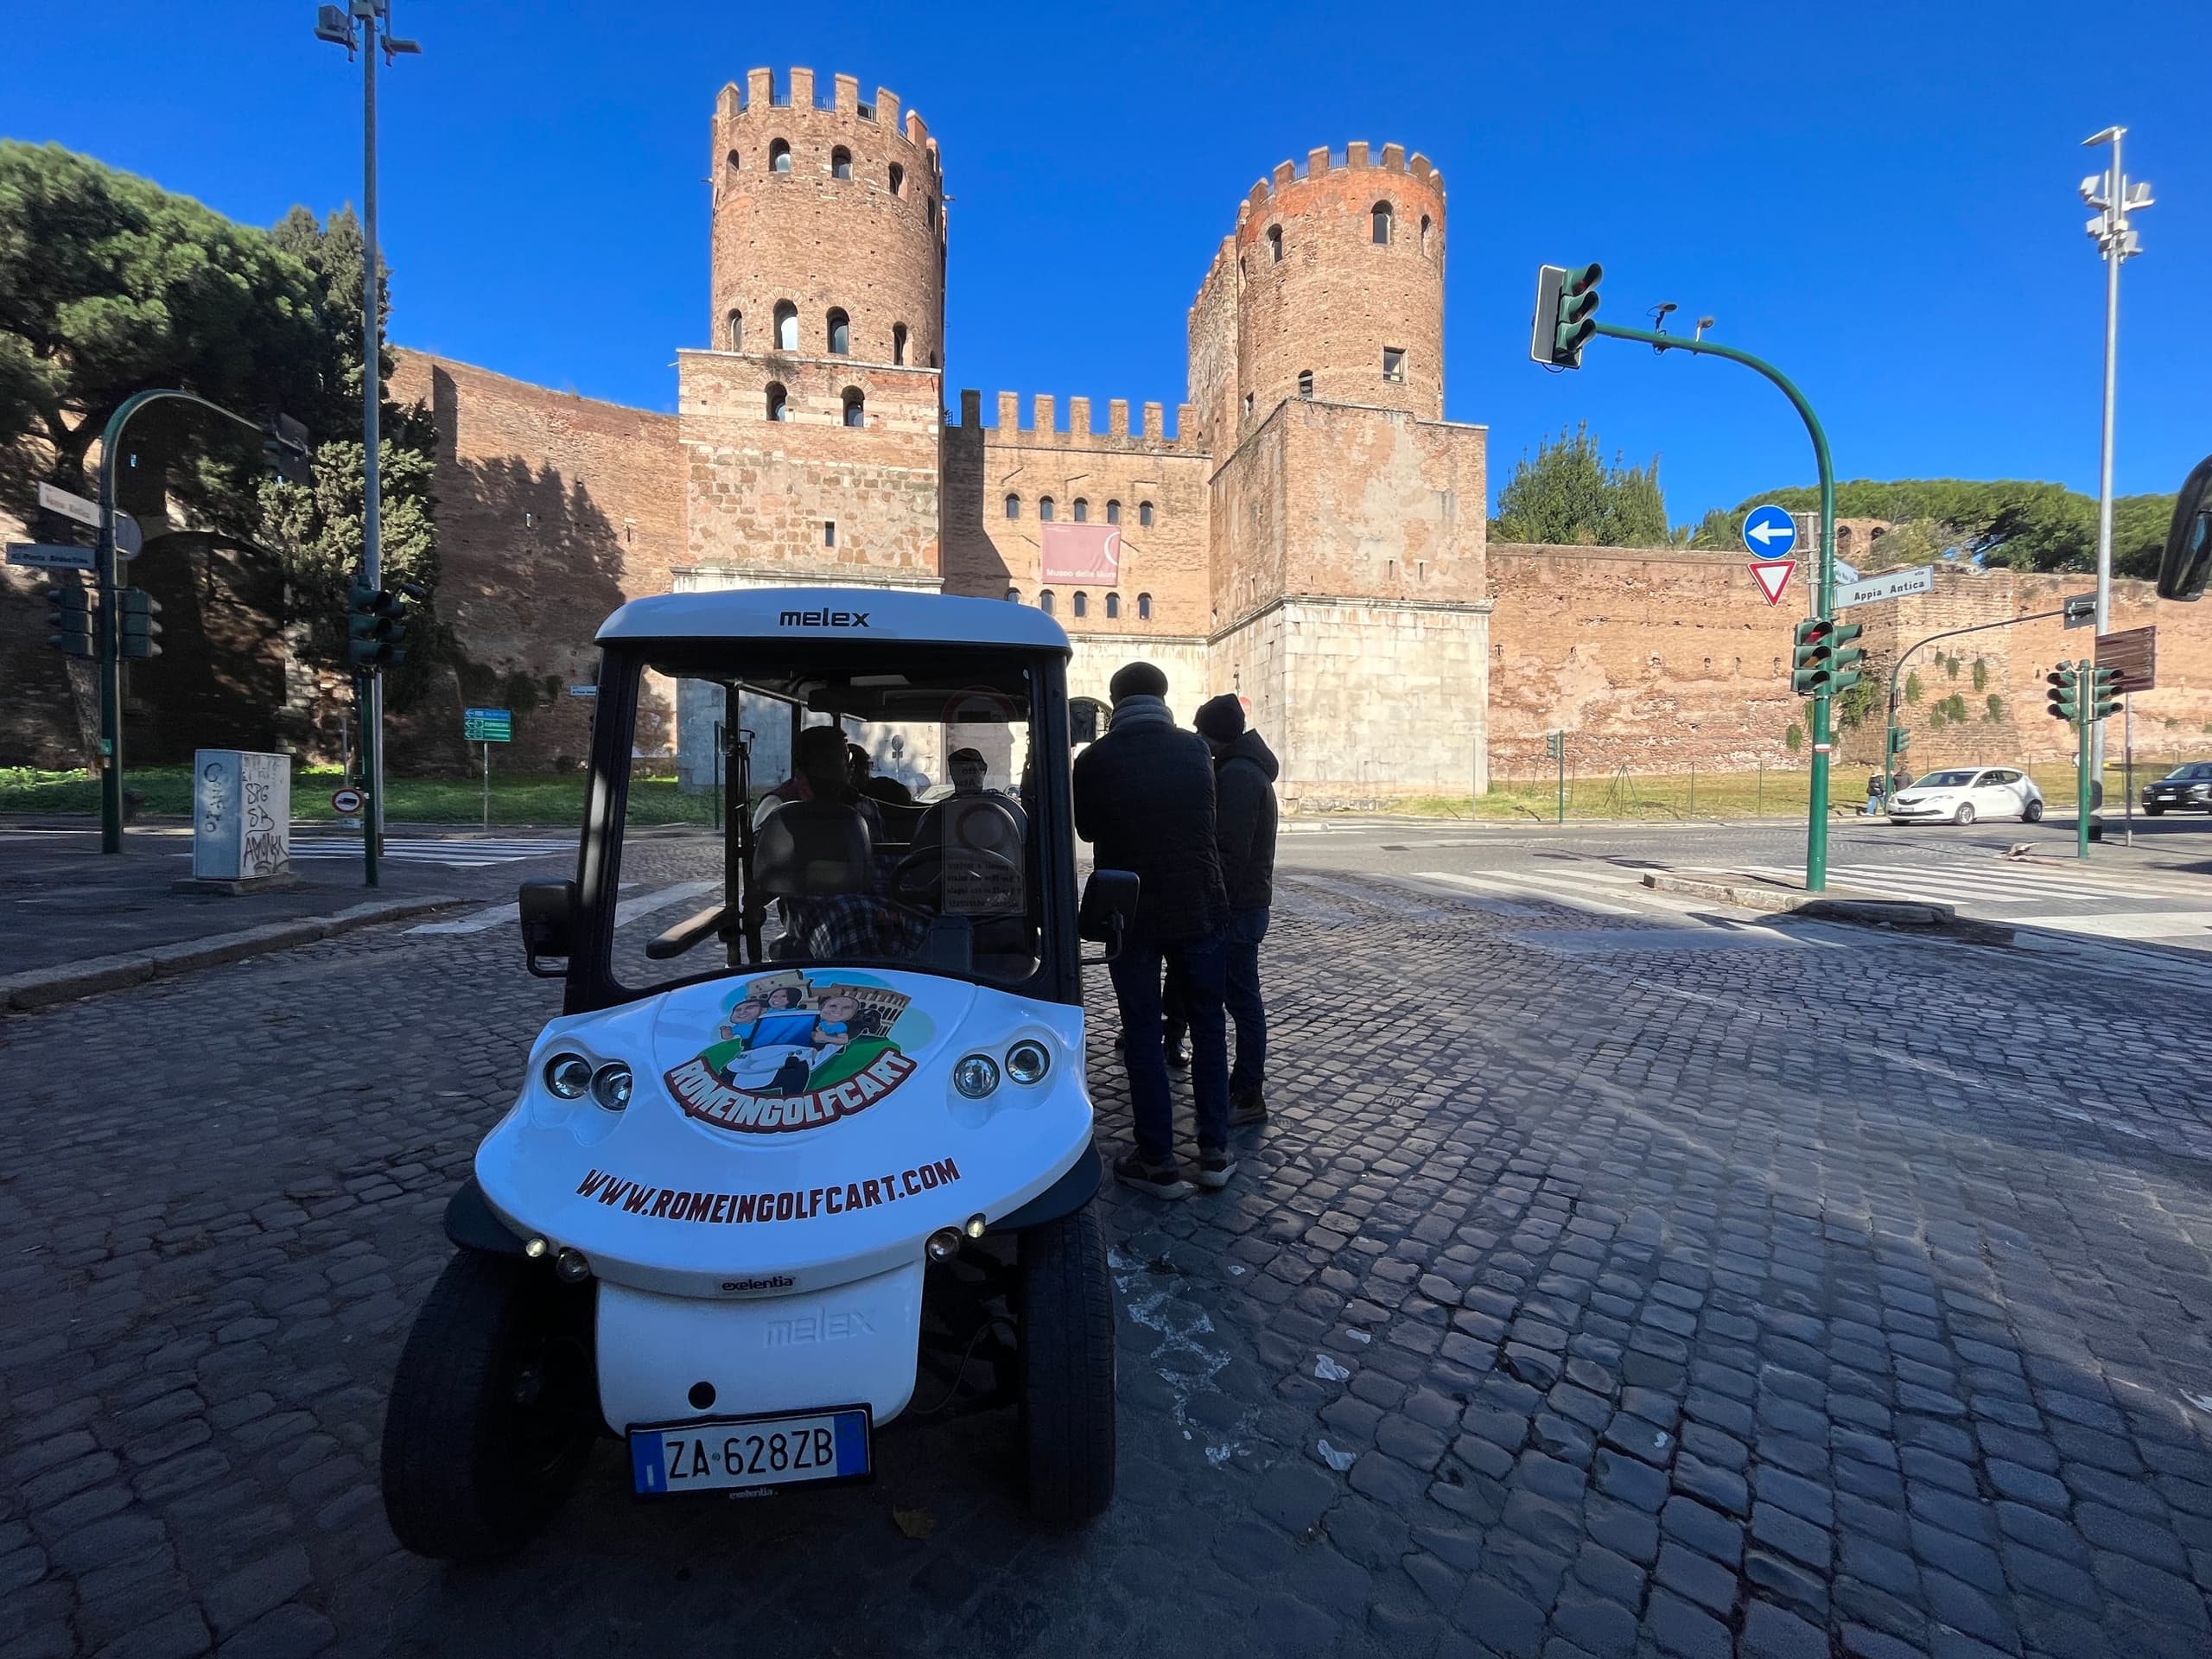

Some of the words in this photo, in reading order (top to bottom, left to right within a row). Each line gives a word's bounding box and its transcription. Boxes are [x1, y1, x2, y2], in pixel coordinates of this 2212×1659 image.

[1046, 569, 1073, 577] Museo
[1075, 569, 1095, 578] delle
[1854, 589, 1882, 601] Appia
[1890, 581, 1925, 594] Antica
[779, 607, 871, 627] melex
[671, 1050, 911, 1127] ROMEINGOLFCART
[575, 1157, 961, 1224] WWW.ROMEINGOLFCART.COM
[721, 1275, 794, 1291] exelentia
[765, 1306, 876, 1348] melex
